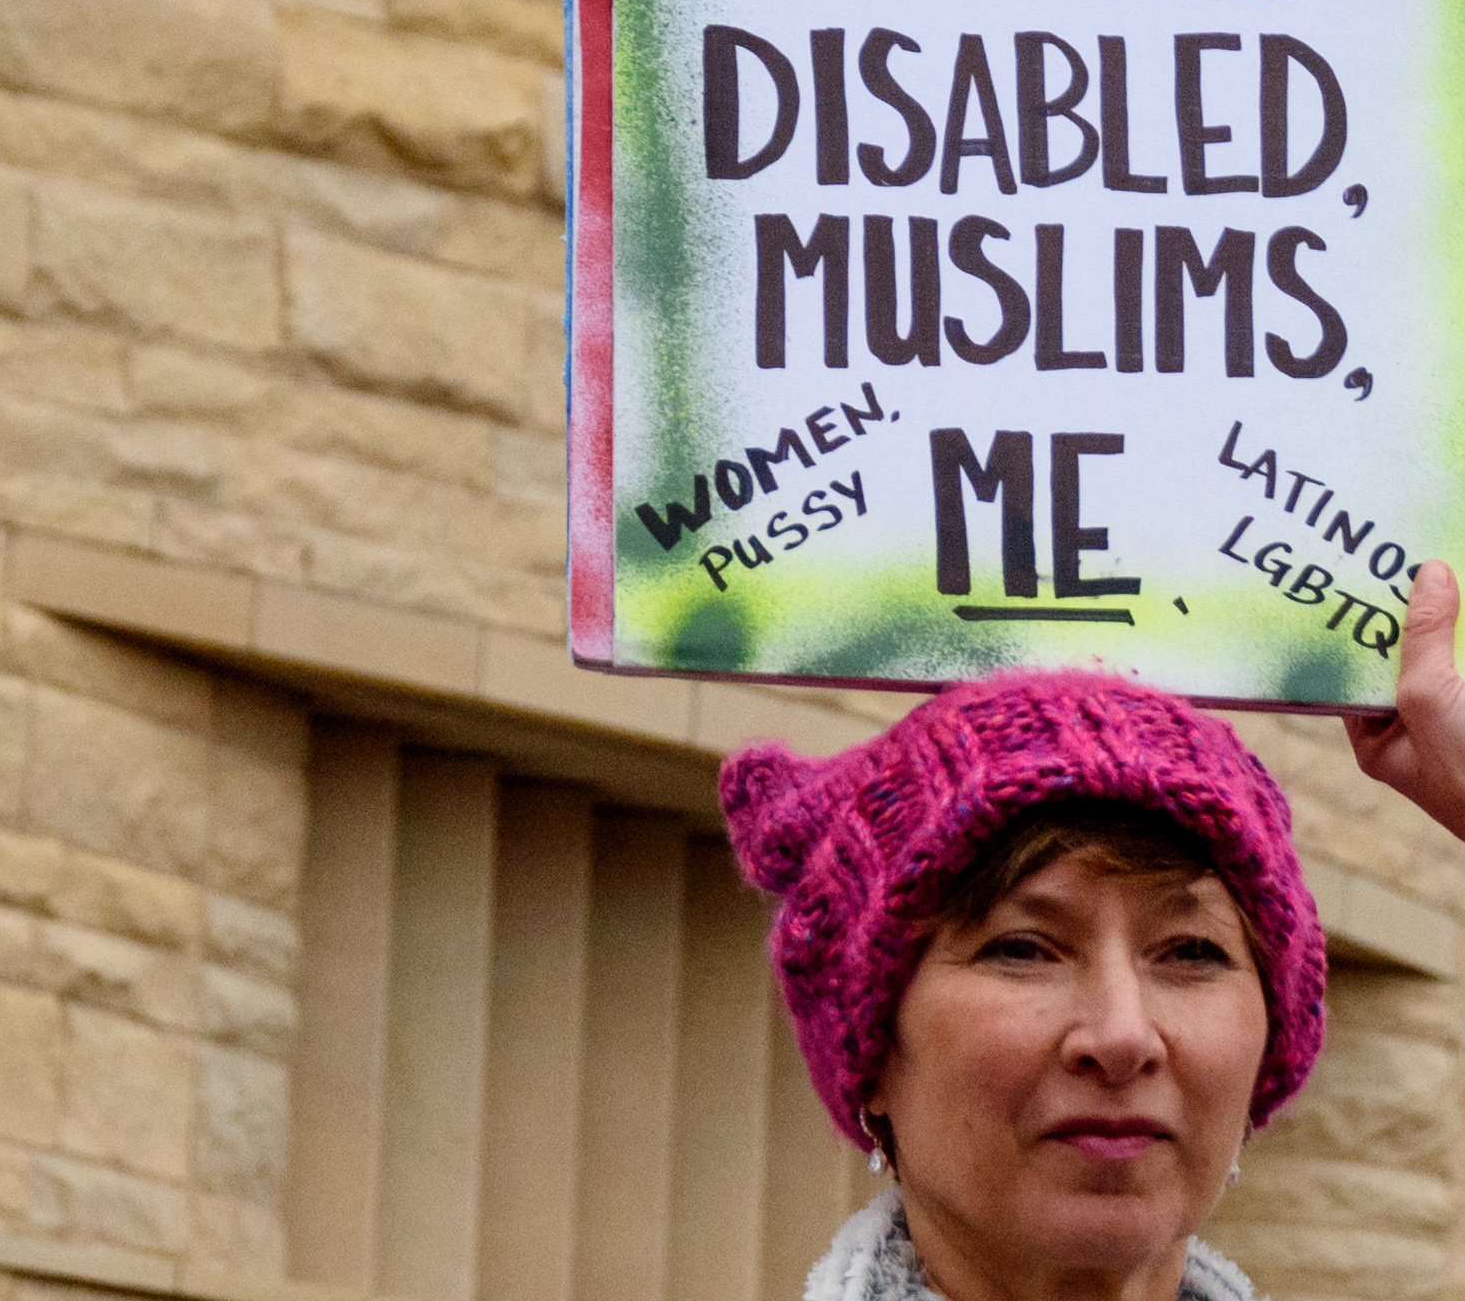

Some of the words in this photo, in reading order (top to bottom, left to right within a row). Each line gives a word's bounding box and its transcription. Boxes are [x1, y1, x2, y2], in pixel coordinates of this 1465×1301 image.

[702, 24, 1371, 220] DISABLED,
[754, 212, 1374, 403] MUSLIMS,
[1218, 515, 1400, 659] LGBTQ
